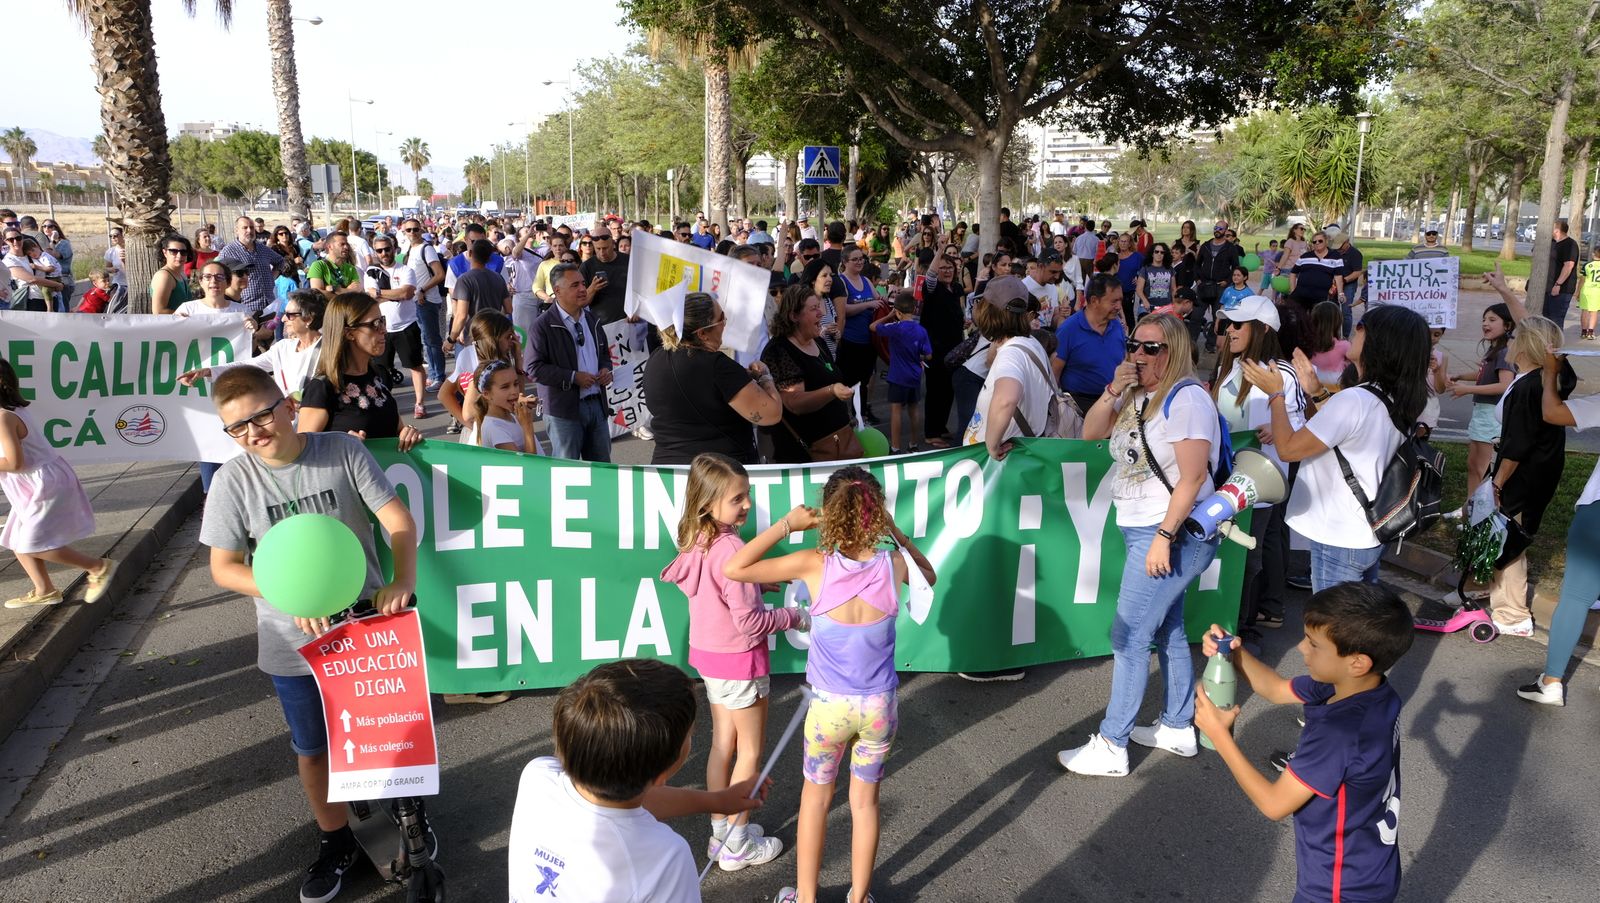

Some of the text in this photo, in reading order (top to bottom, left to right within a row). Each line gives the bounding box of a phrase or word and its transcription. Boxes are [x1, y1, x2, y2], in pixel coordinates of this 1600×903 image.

[1377, 289, 1448, 301] NIFESTACIÓN
[0, 340, 36, 401] E
[43, 409, 107, 448] CÁ
[372, 463, 525, 552] OLE
[550, 466, 592, 549] E
[456, 579, 553, 669] EN
[580, 577, 672, 661] LA
[319, 629, 400, 657] POR UNA
[322, 648, 418, 678] EDUCACIÓN
[354, 677, 406, 697] DIGNA
[356, 711, 424, 728] Más población
[359, 740, 414, 754] Más colegios
[340, 781, 361, 790] AMPA
[394, 776, 424, 786] GRANDE
[534, 848, 565, 869] MUJER
